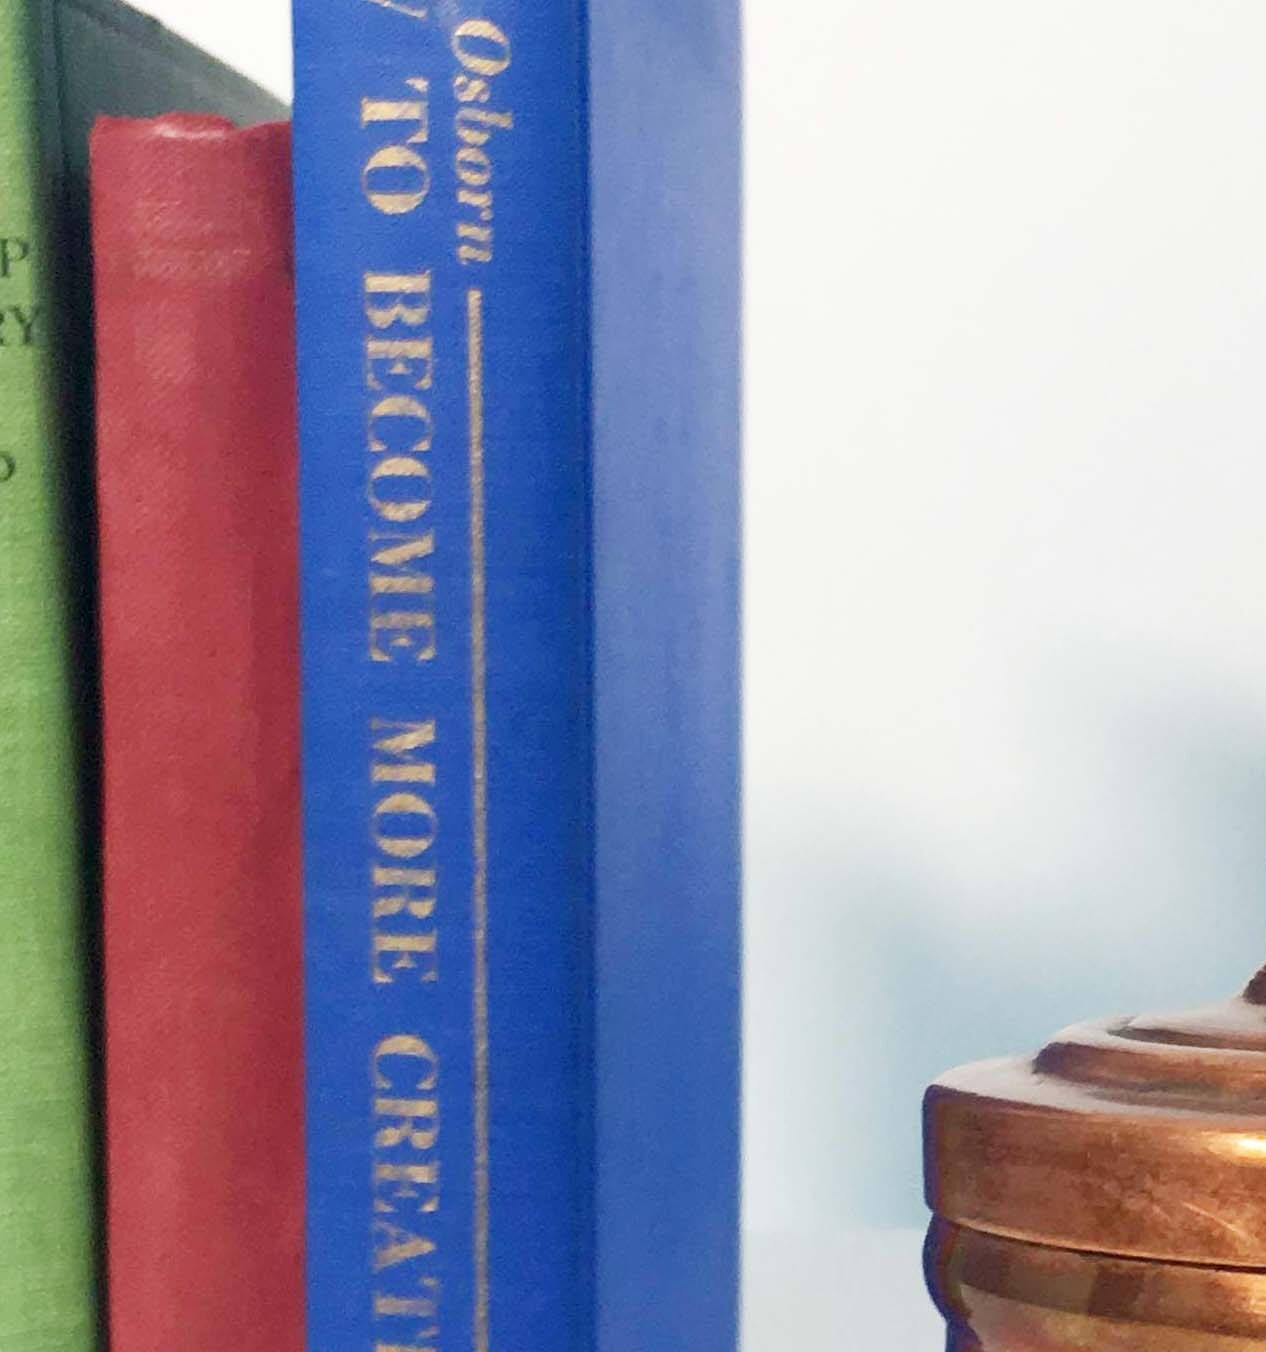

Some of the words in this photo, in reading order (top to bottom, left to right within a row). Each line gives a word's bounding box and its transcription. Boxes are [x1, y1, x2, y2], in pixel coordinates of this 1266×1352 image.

[360, 76, 431, 215] TO
[452, 18, 514, 264] Osborn
[363, 270, 437, 662] BECOME
[369, 717, 439, 984] MORE
